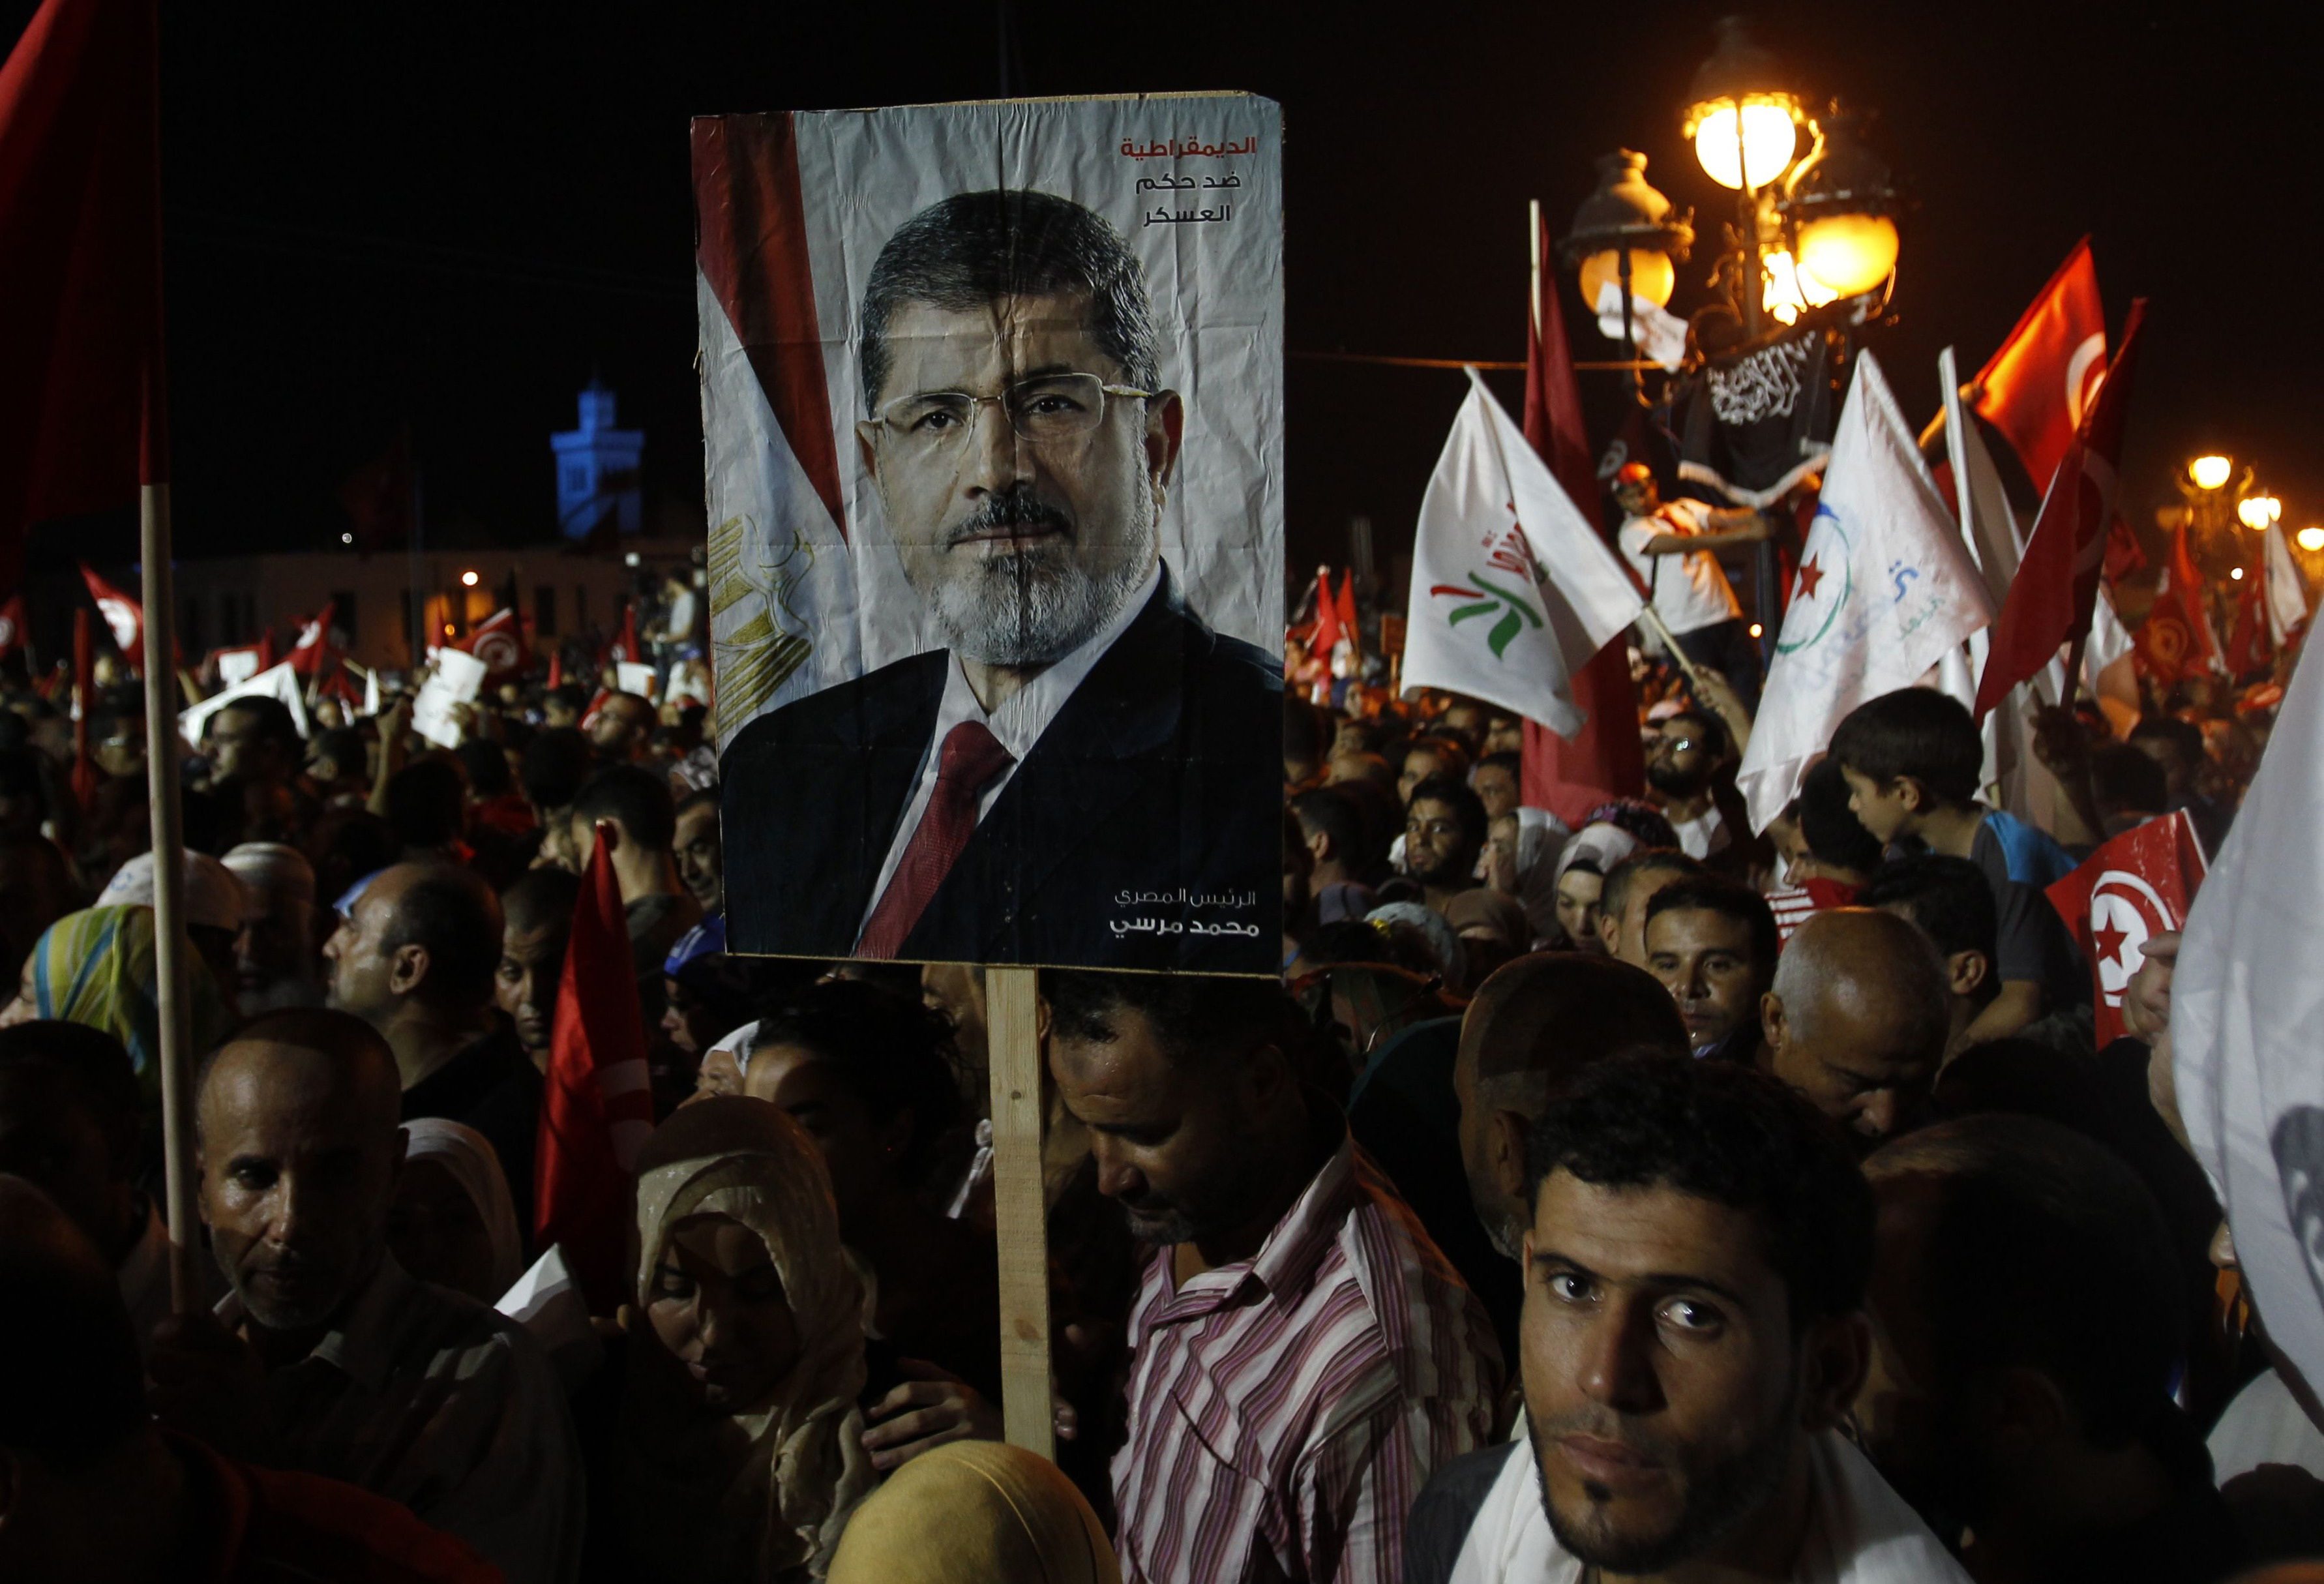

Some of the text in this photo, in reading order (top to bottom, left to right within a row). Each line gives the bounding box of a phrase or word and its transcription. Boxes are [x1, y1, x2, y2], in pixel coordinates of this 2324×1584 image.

[1120, 136, 1257, 161] الديمقراطية
[1136, 171, 1241, 194] ضد حكم
[1143, 205, 1230, 227] العسكر
[1114, 887, 1256, 909] الرئيس المصري
[1109, 916, 1260, 939] محمد مرسي
